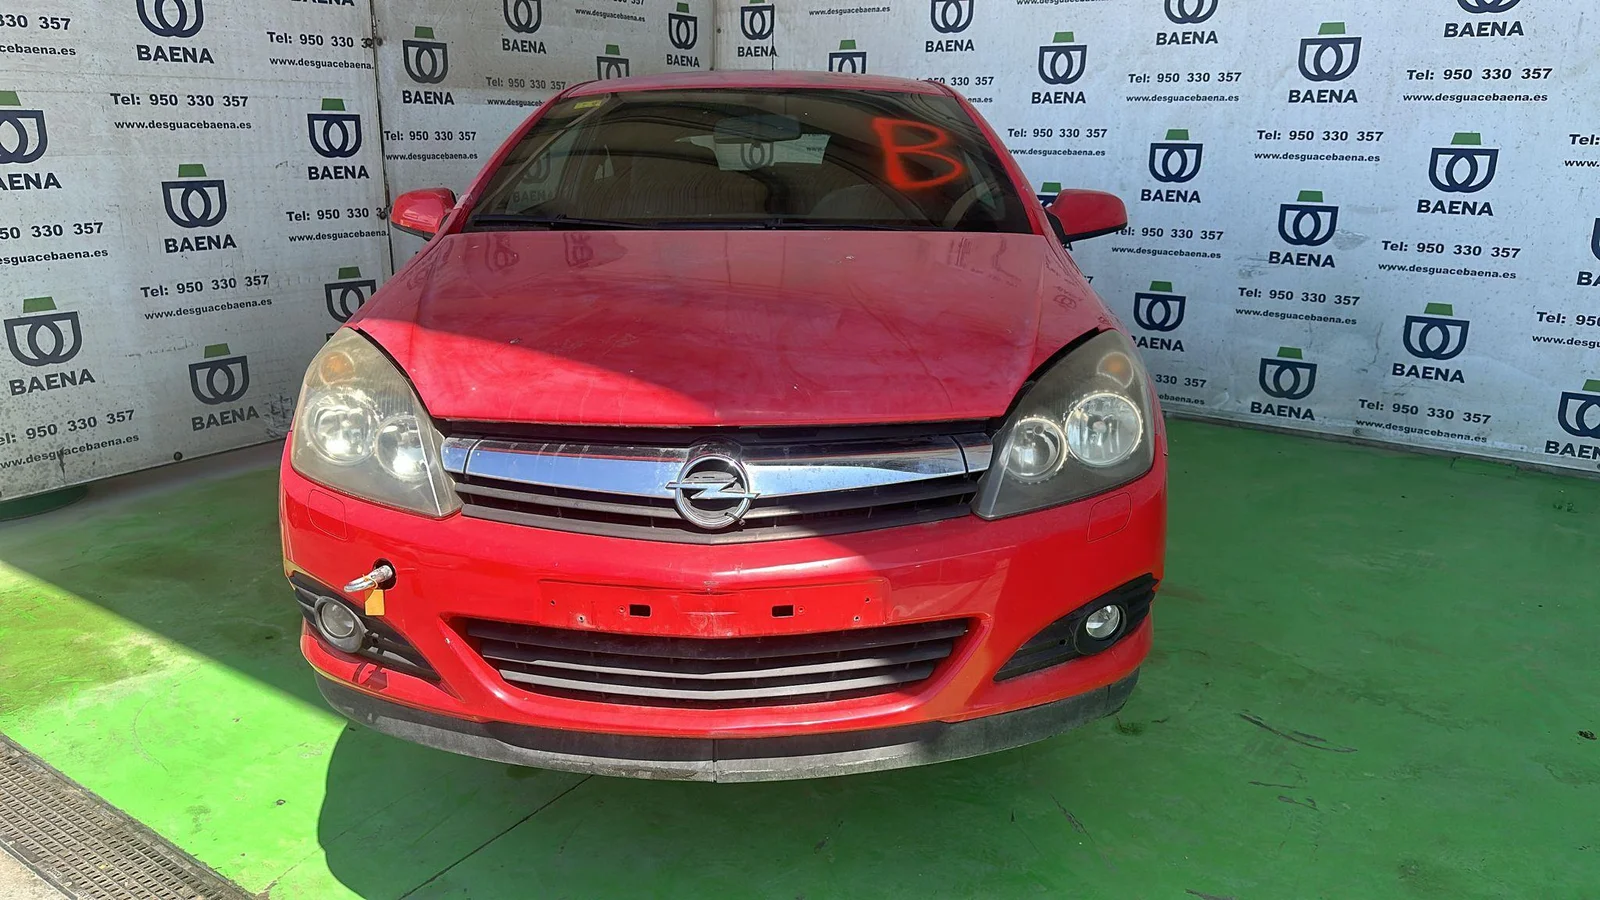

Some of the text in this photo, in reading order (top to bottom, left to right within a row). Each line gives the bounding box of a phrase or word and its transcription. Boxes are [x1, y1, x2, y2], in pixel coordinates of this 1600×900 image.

[575, 9, 645, 22] www.desguacebaena.es
[809, 6, 890, 16] www.desguacebaena.es
[39, 16, 71, 30] 357
[1444, 21, 1524, 38] BAENA
[266, 31, 292, 44] Tel:
[299, 34, 323, 46] 950
[331, 36, 354, 48] 330
[1156, 30, 1218, 45] BAENA
[502, 38, 547, 54] BAENA
[737, 45, 777, 58] BAENA
[925, 39, 975, 53] BAENA
[136, 44, 214, 64] BAENA
[666, 54, 700, 68] BAENA
[951, 77, 969, 86] 330
[975, 76, 994, 86] 357
[1128, 72, 1242, 83] Tel: 950 330 357
[1407, 68, 1553, 80] Tel: 950 330 357
[485, 76, 566, 90] Tel: 950 330 357
[110, 93, 248, 107] Tel: 950 330 357
[402, 90, 455, 105] BAENA
[1031, 91, 1086, 104] BAENA
[1126, 94, 1239, 103] www.desguacebaena.es
[1288, 89, 1358, 103] BAENA
[1403, 93, 1548, 103] www.desguacebaena.es
[114, 120, 252, 131] www.desguacebaena.es
[384, 131, 476, 141] Tel: 950 330 357
[1007, 128, 1108, 138] Tel: 950 330 357
[1257, 130, 1384, 141] Tel: 950 330 357
[1569, 134, 1600, 145] Tel:
[386, 152, 478, 162] www.desguacebaena.es
[872, 116, 966, 191] B
[1254, 152, 1380, 162] www.desguacebaena.es
[308, 165, 370, 180] BAENA
[1141, 189, 1201, 203] BAENA
[286, 211, 310, 221] Tel:
[317, 209, 340, 220] 950
[347, 208, 369, 218] 330
[1417, 199, 1493, 216] BAENA
[31, 224, 63, 238] 330
[73, 222, 103, 235] 357
[1142, 227, 1164, 237] 950
[1170, 229, 1193, 239] 330
[1200, 230, 1224, 240] 357
[164, 234, 237, 253] BAENA
[1381, 240, 1521, 258] Tel: 950 330 357
[1111, 247, 1221, 259] www.desguacebaena.es
[1268, 251, 1335, 268] BAENA
[1378, 264, 1516, 279] www.desguacebaena.es
[140, 275, 269, 298] Tel: 950 330 357
[1238, 287, 1360, 306] Tel: 950 330 357
[144, 299, 272, 320] www.desguacebaena.es
[1235, 308, 1357, 325] www.desguacebaena.es
[1536, 311, 1600, 327] Tel: 95
[1392, 363, 1465, 383] BAENA
[9, 368, 96, 396] BAENA
[1155, 374, 1207, 388] 330 357
[1157, 393, 1205, 406] ebaena.es
[1250, 401, 1315, 421] BAENA
[1358, 399, 1491, 424] Tel: 950 330 357
[26, 424, 58, 439] 950
[67, 416, 97, 432] 330
[106, 409, 134, 424] 357
[191, 406, 260, 431] BAENA
[1356, 419, 1488, 443] www.desguacebaena.es
